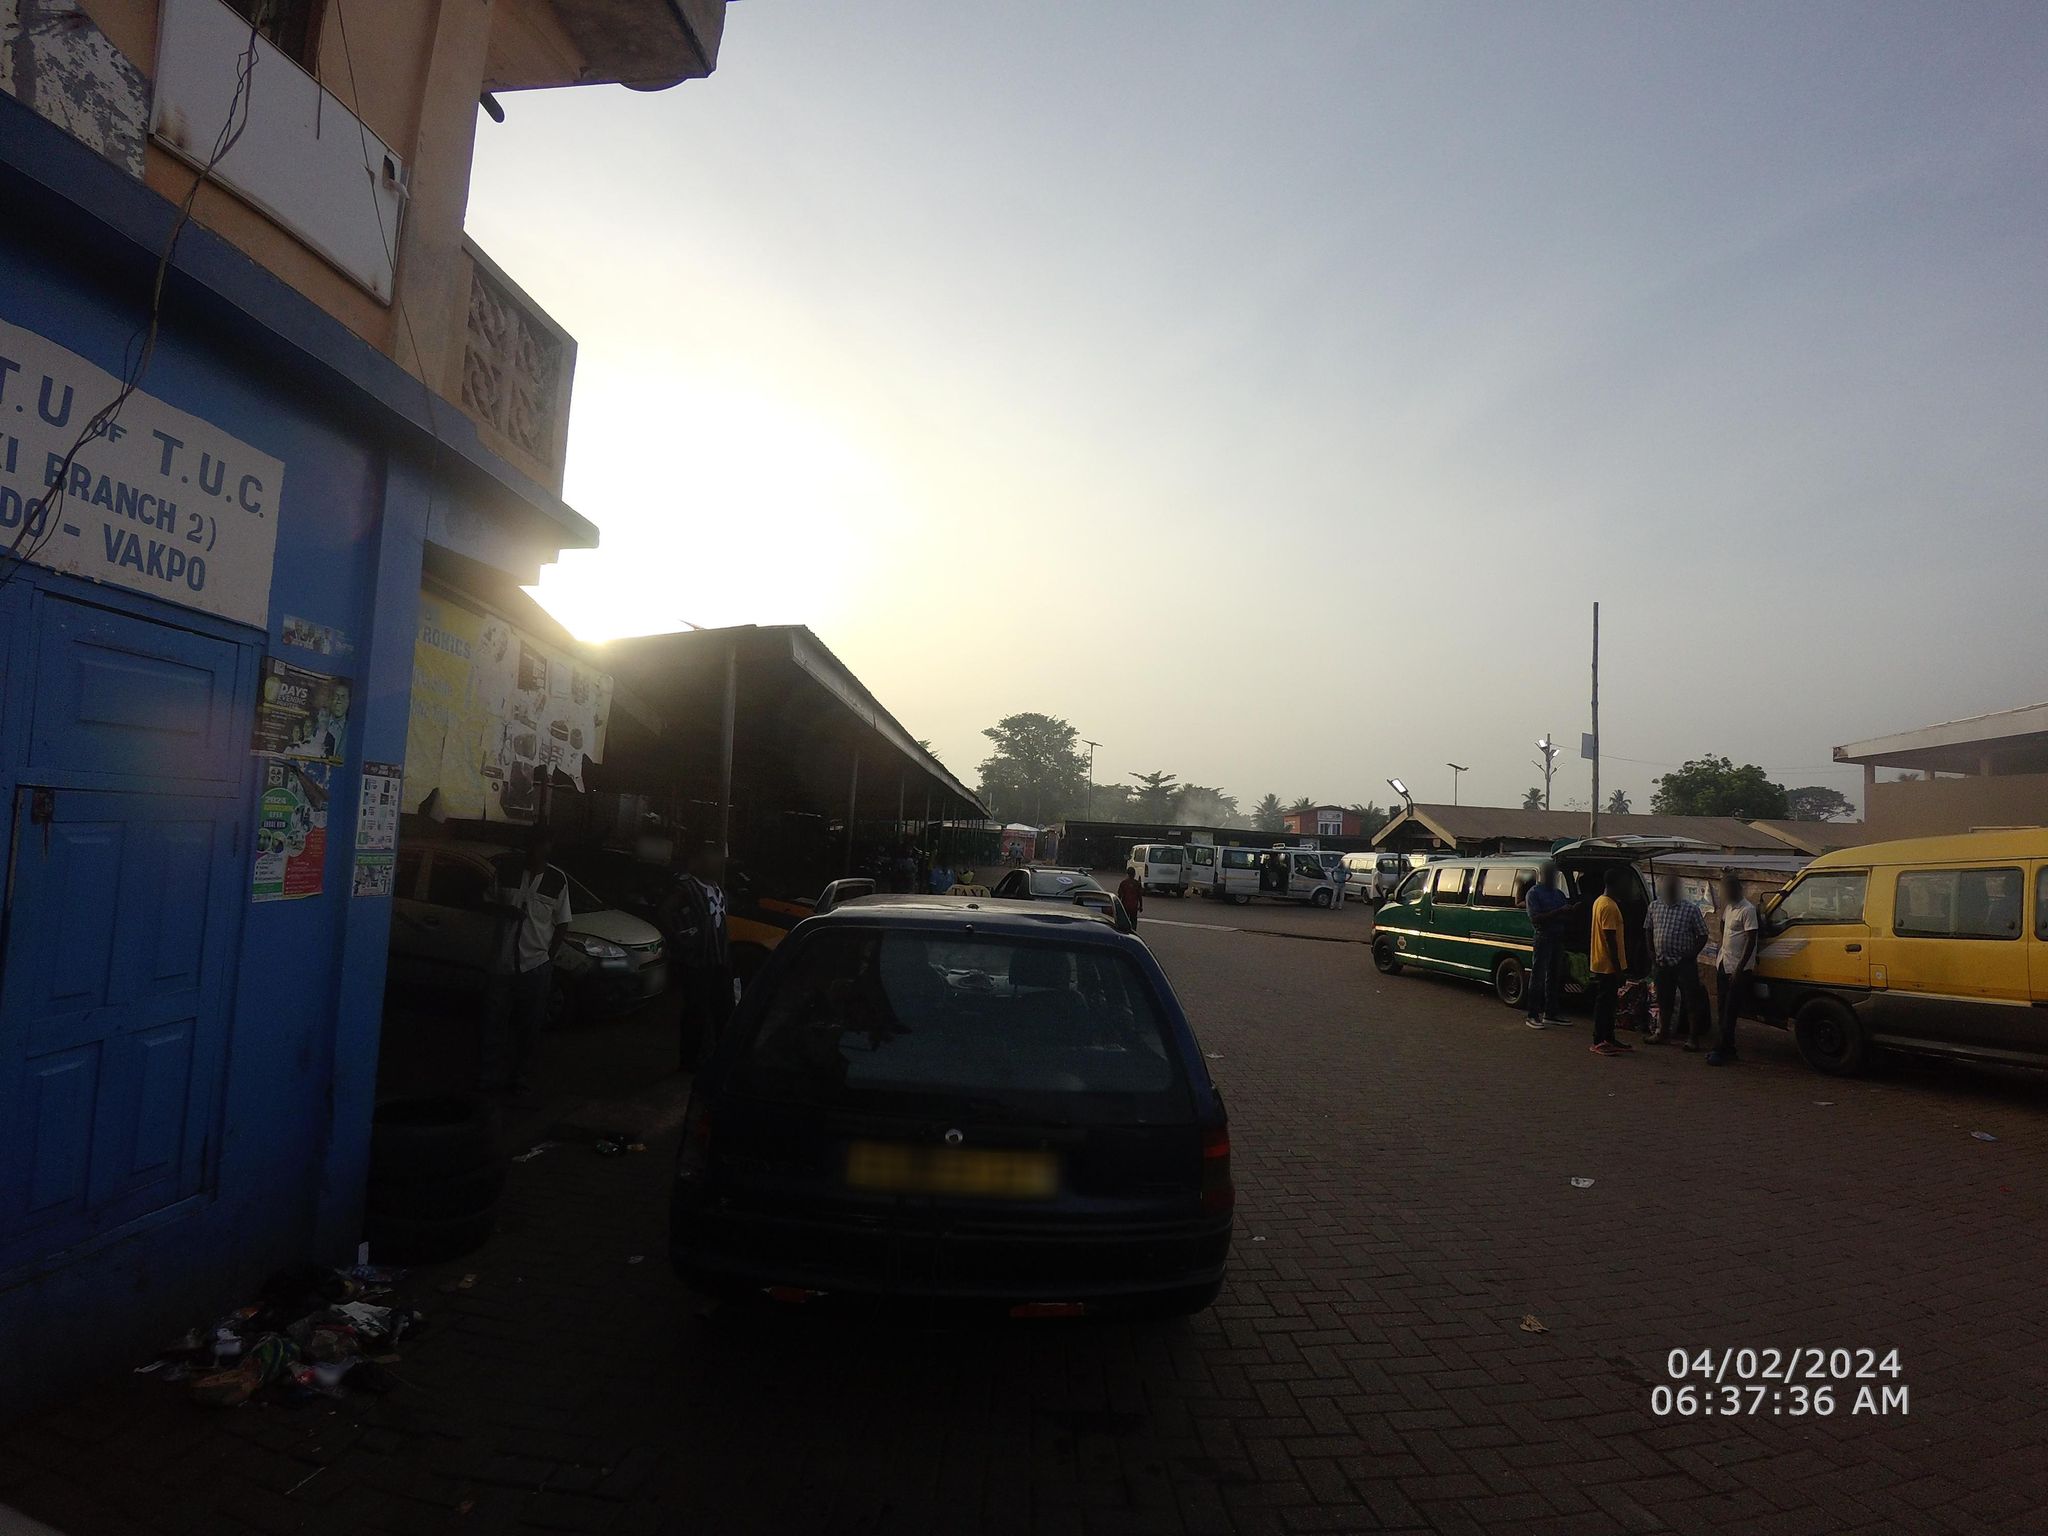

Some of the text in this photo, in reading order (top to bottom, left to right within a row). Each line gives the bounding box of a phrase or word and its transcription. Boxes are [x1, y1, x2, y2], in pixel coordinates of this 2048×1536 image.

[43, 452, 177, 534] BRANCH
[186, 513, 217, 551] 2)
[91, 417, 127, 443] OF
[153, 428, 264, 518] T.U.C.
[103, 523, 206, 591] VAKPO
[280, 683, 308, 698] DAYS
[952, 887, 984, 897] TAXI
